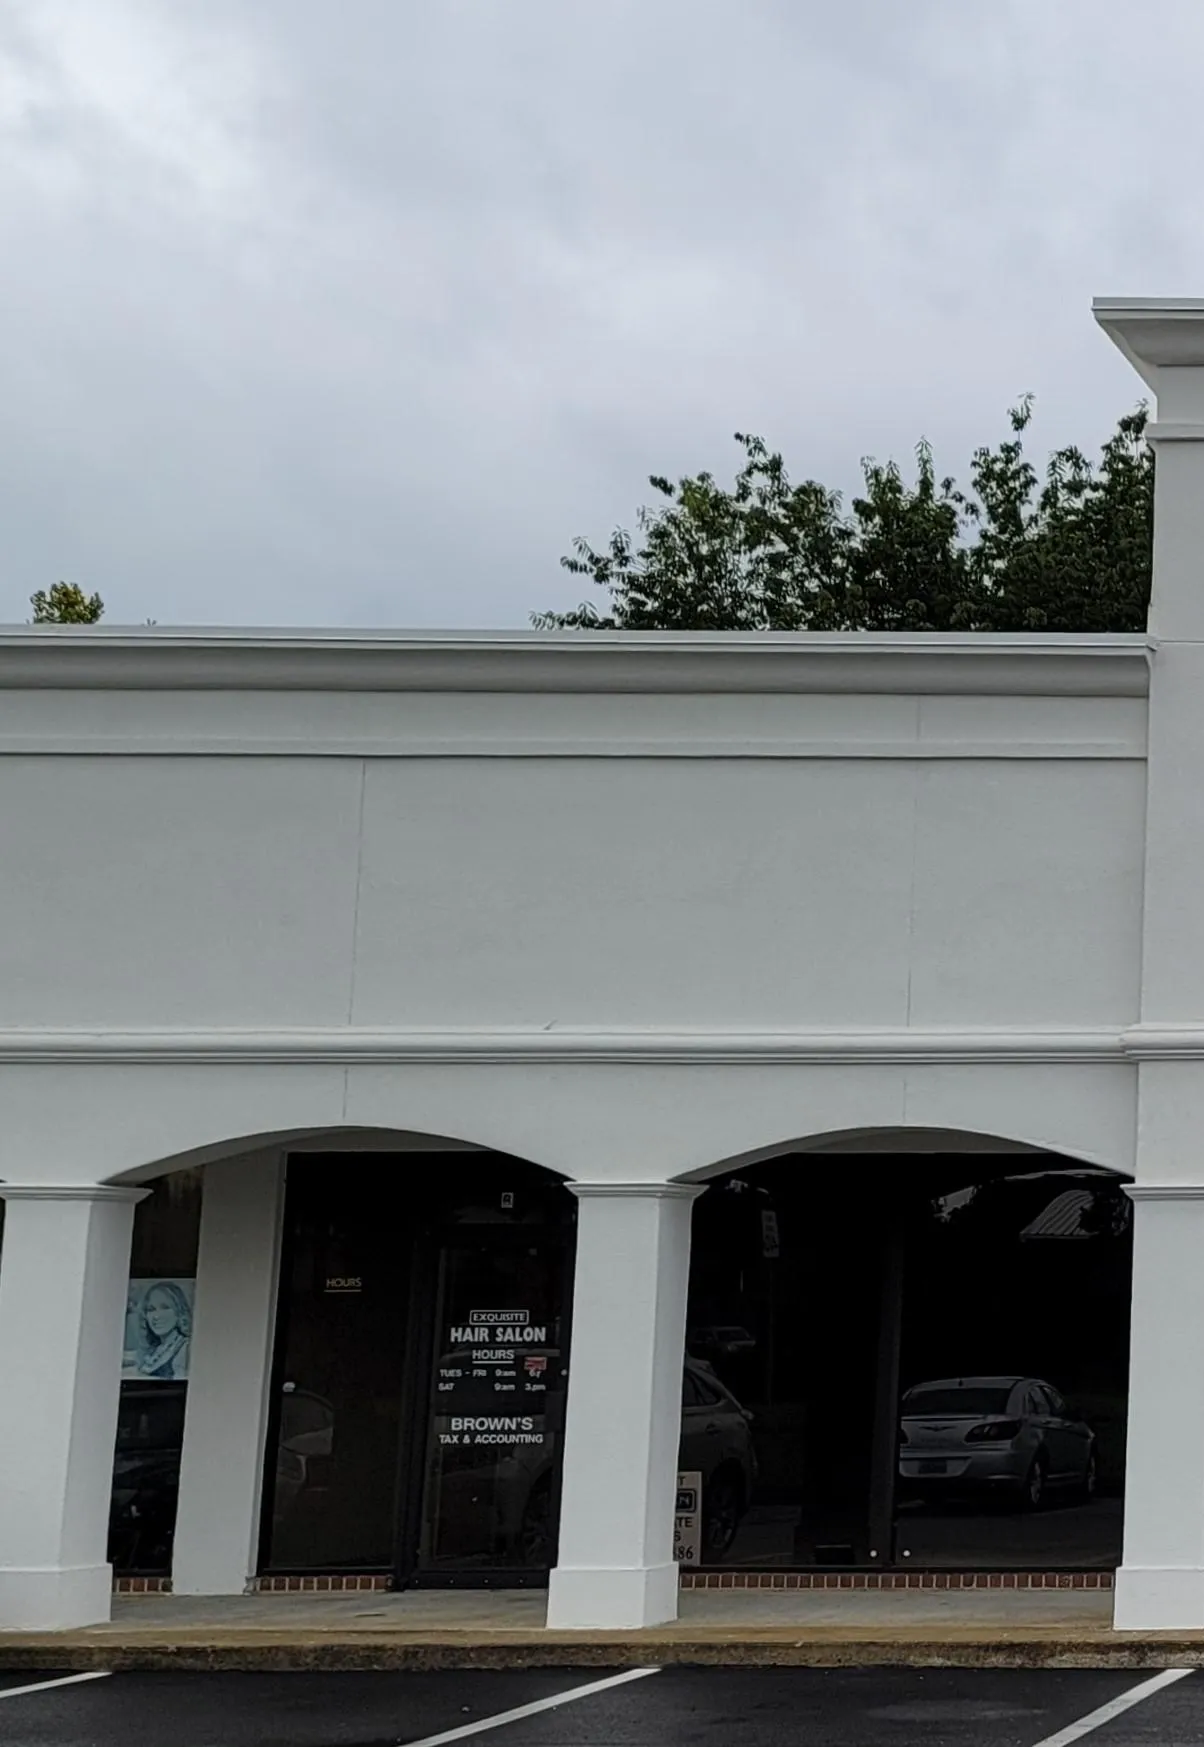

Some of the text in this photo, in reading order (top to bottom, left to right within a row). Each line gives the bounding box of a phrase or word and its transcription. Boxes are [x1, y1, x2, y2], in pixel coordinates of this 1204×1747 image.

[326, 1277, 362, 1288] HOURS
[473, 1313, 526, 1322] EXQUISITE
[450, 1327, 547, 1342] HAIR SALON
[472, 1349, 515, 1360] HOURS
[439, 1369, 462, 1377] TUES
[472, 1369, 487, 1377] FRI
[438, 1382, 455, 1391] SAT
[451, 1417, 534, 1431] BROWN'S
[439, 1434, 544, 1444] TAX & ACCOUNTING
[674, 1517, 693, 1527] TE
[675, 1546, 693, 1559] 86
